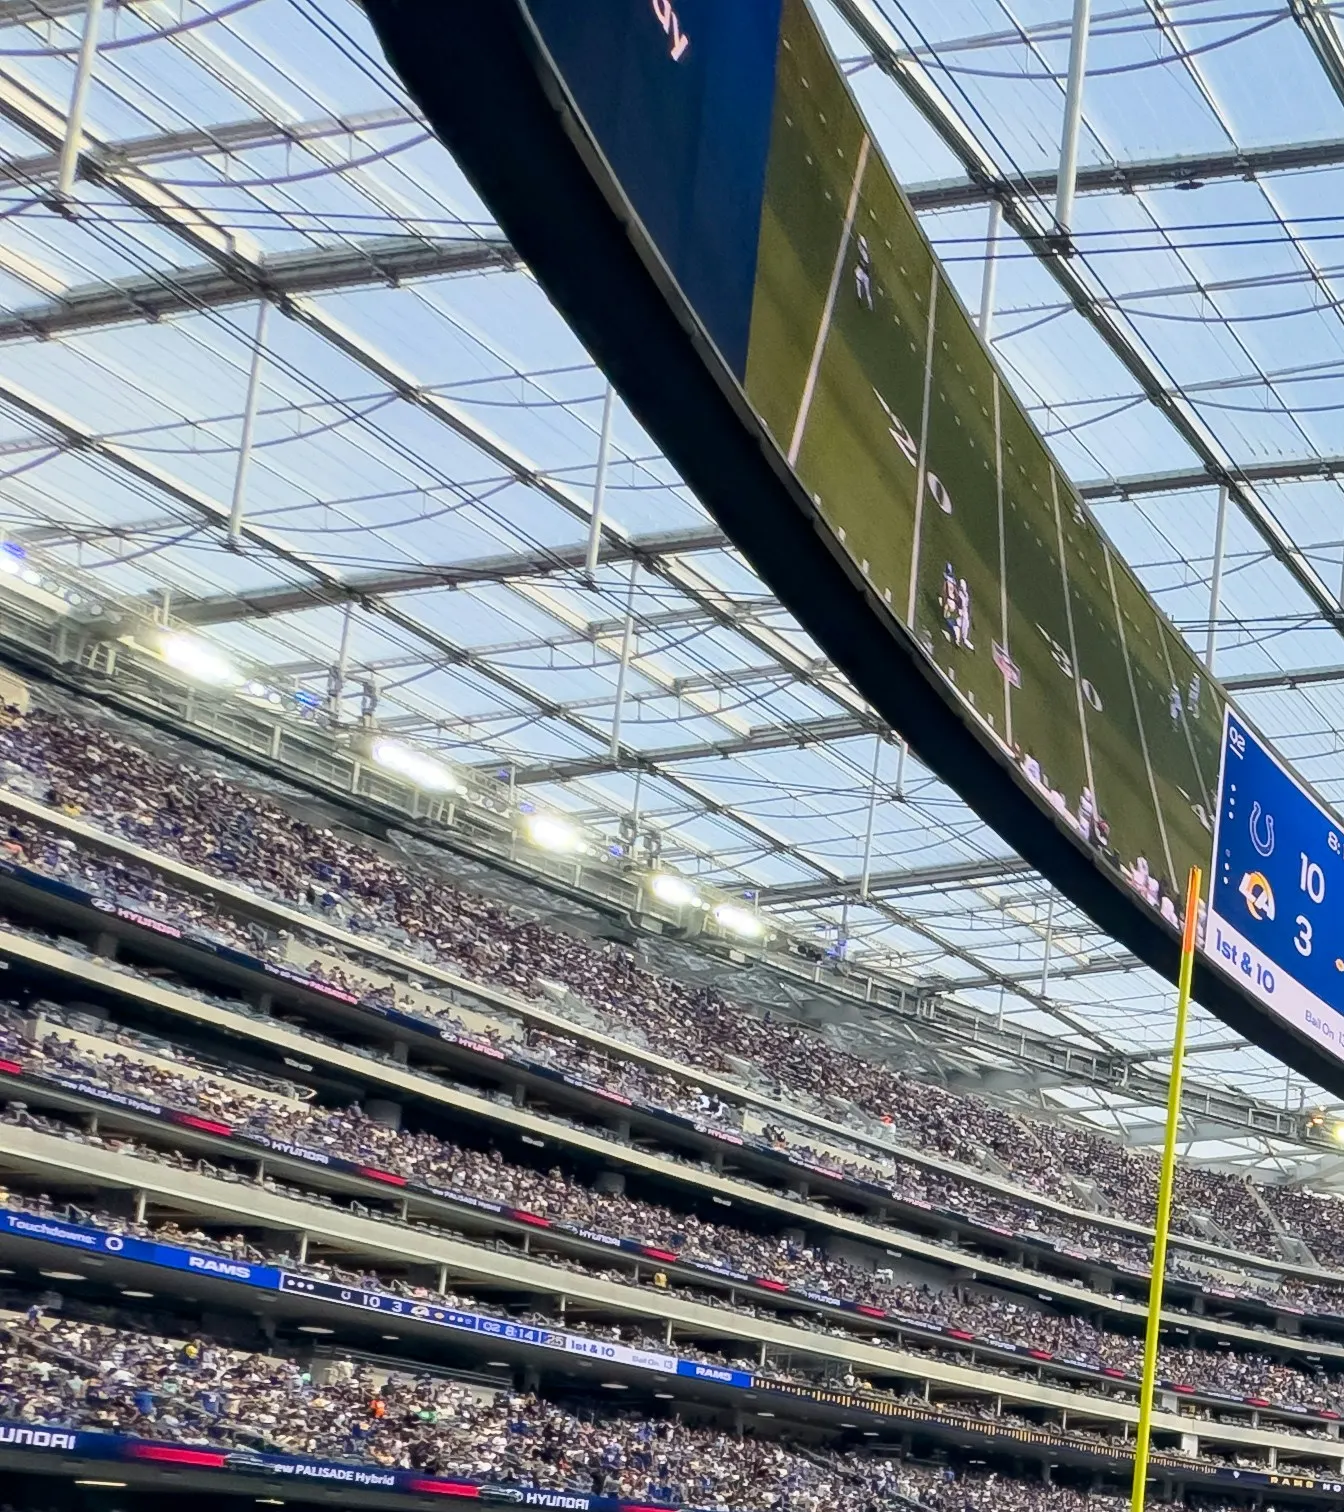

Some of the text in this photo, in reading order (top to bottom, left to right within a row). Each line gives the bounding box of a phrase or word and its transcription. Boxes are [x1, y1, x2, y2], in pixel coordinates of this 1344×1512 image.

[1299, 851, 1327, 905] 10
[1293, 915, 1313, 958] 3
[1215, 928, 1275, 995] 1st & 10
[188, 1256, 251, 1279] RAMS
[362, 1293, 403, 1313] 10 3
[505, 1326, 534, 1342] 8:14
[600, 1346, 615, 1358] 10
[696, 1366, 732, 1381] RAMS
[0, 1428, 76, 1450] UNDAI
[296, 1465, 353, 1480] PALISADE
[356, 1471, 395, 1486] Hybrid
[526, 1493, 589, 1511] HYUNDAI
